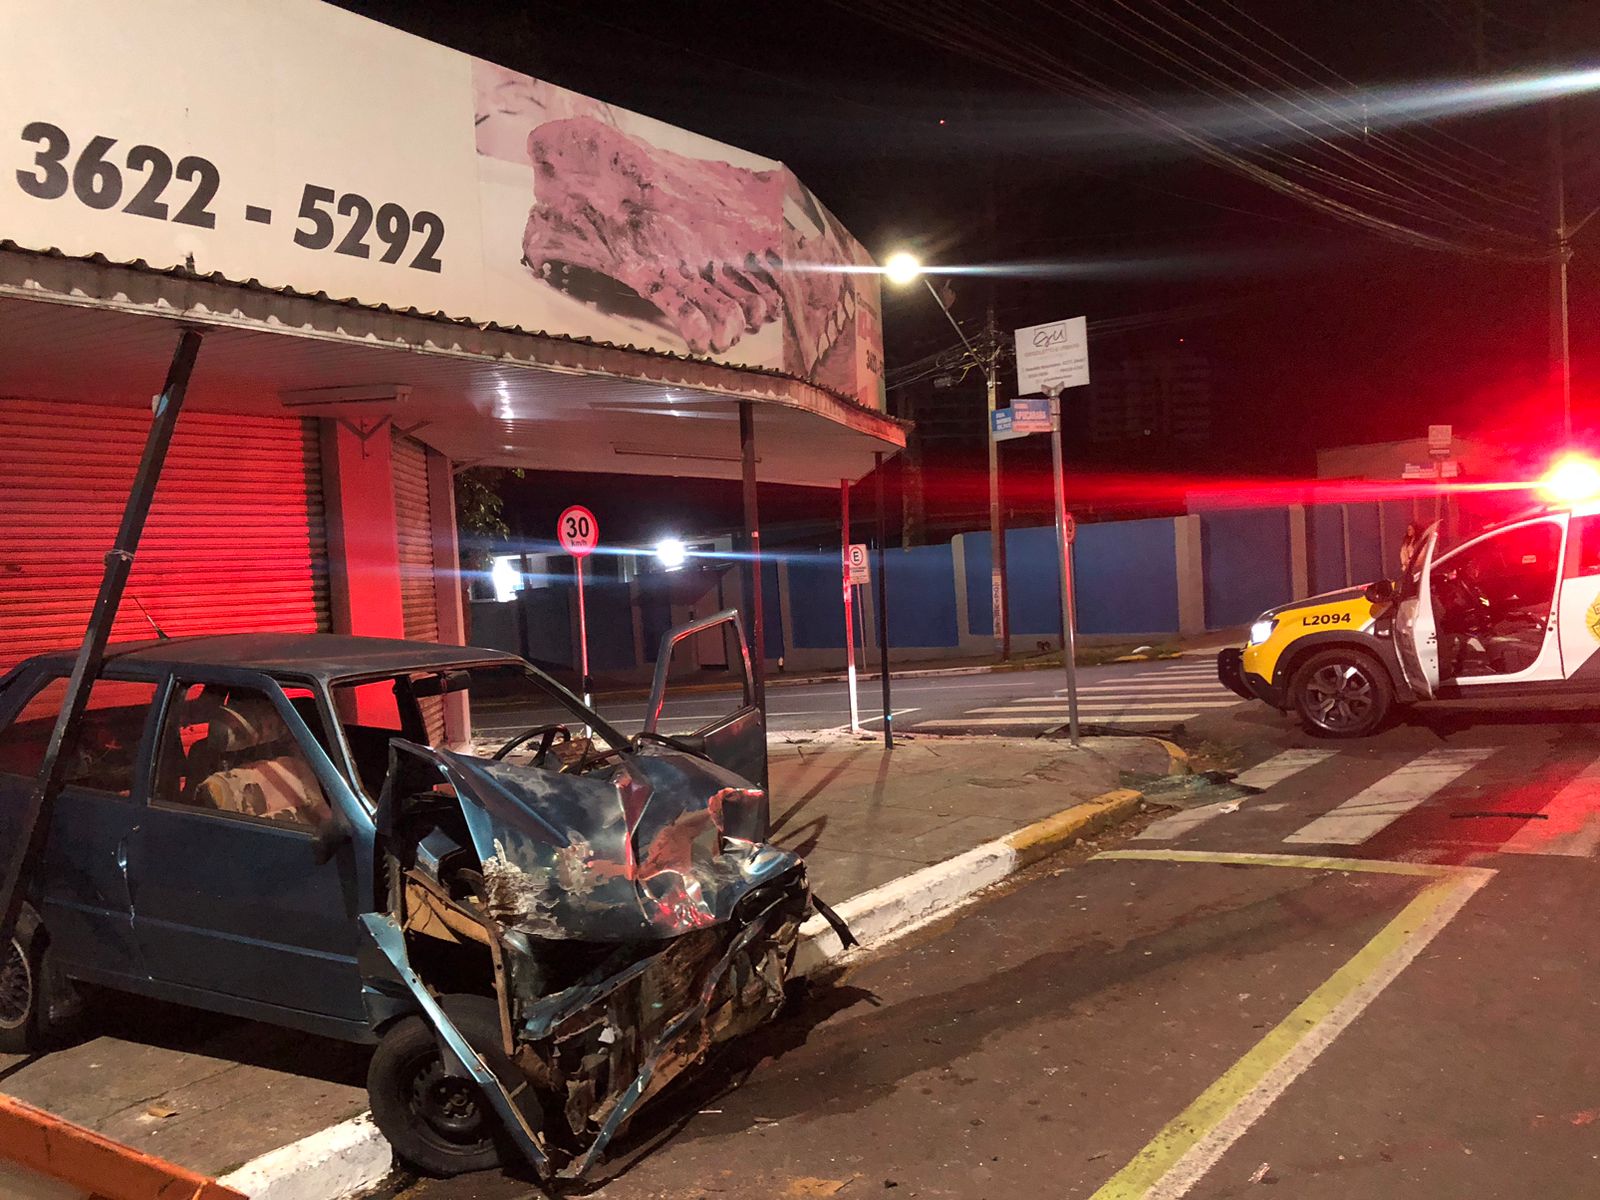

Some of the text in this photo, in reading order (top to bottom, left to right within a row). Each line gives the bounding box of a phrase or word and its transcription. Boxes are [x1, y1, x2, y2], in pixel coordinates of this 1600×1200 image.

[16, 121, 445, 273] 3622 - 5292
[566, 516, 589, 538] 30
[570, 539, 588, 547] km/h
[852, 550, 860, 562] E
[1302, 613, 1351, 627] L2094
